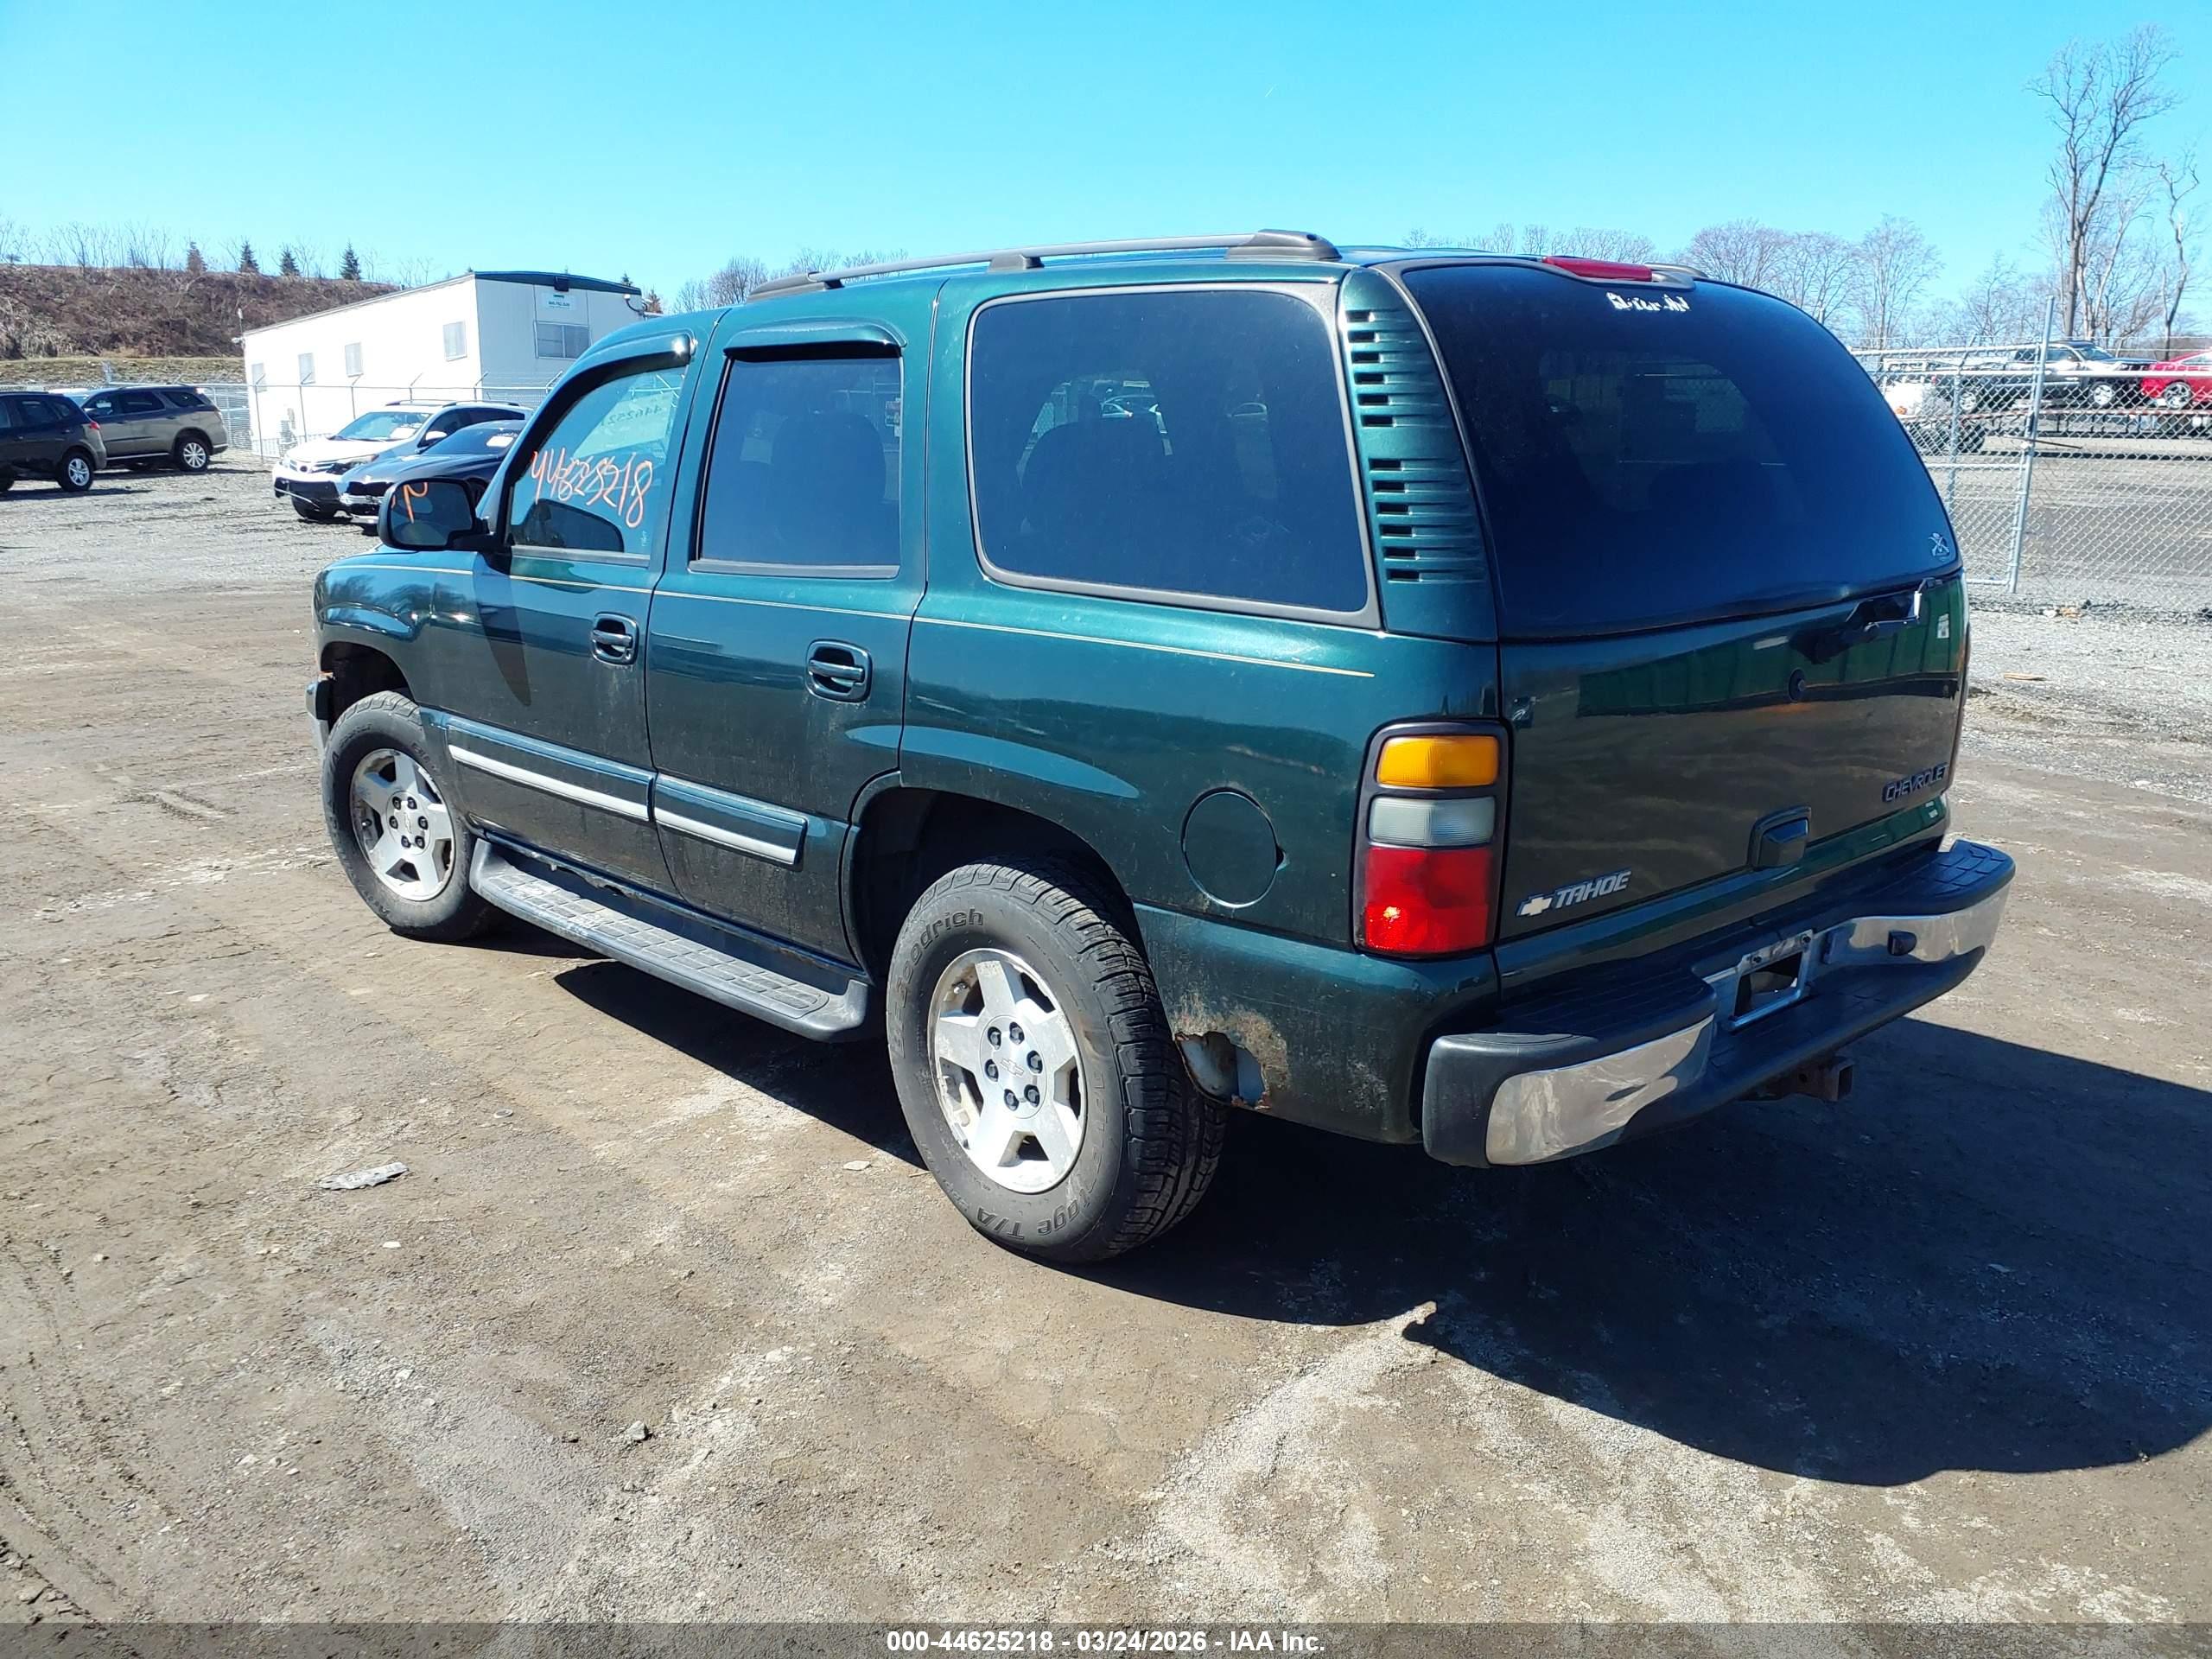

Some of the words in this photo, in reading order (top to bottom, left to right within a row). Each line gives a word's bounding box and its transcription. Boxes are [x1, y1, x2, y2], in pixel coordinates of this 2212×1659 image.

[1882, 762, 1949, 803] CHEVROLET
[1555, 868, 1632, 909] TAHOE
[976, 1206, 1025, 1241] T/A
